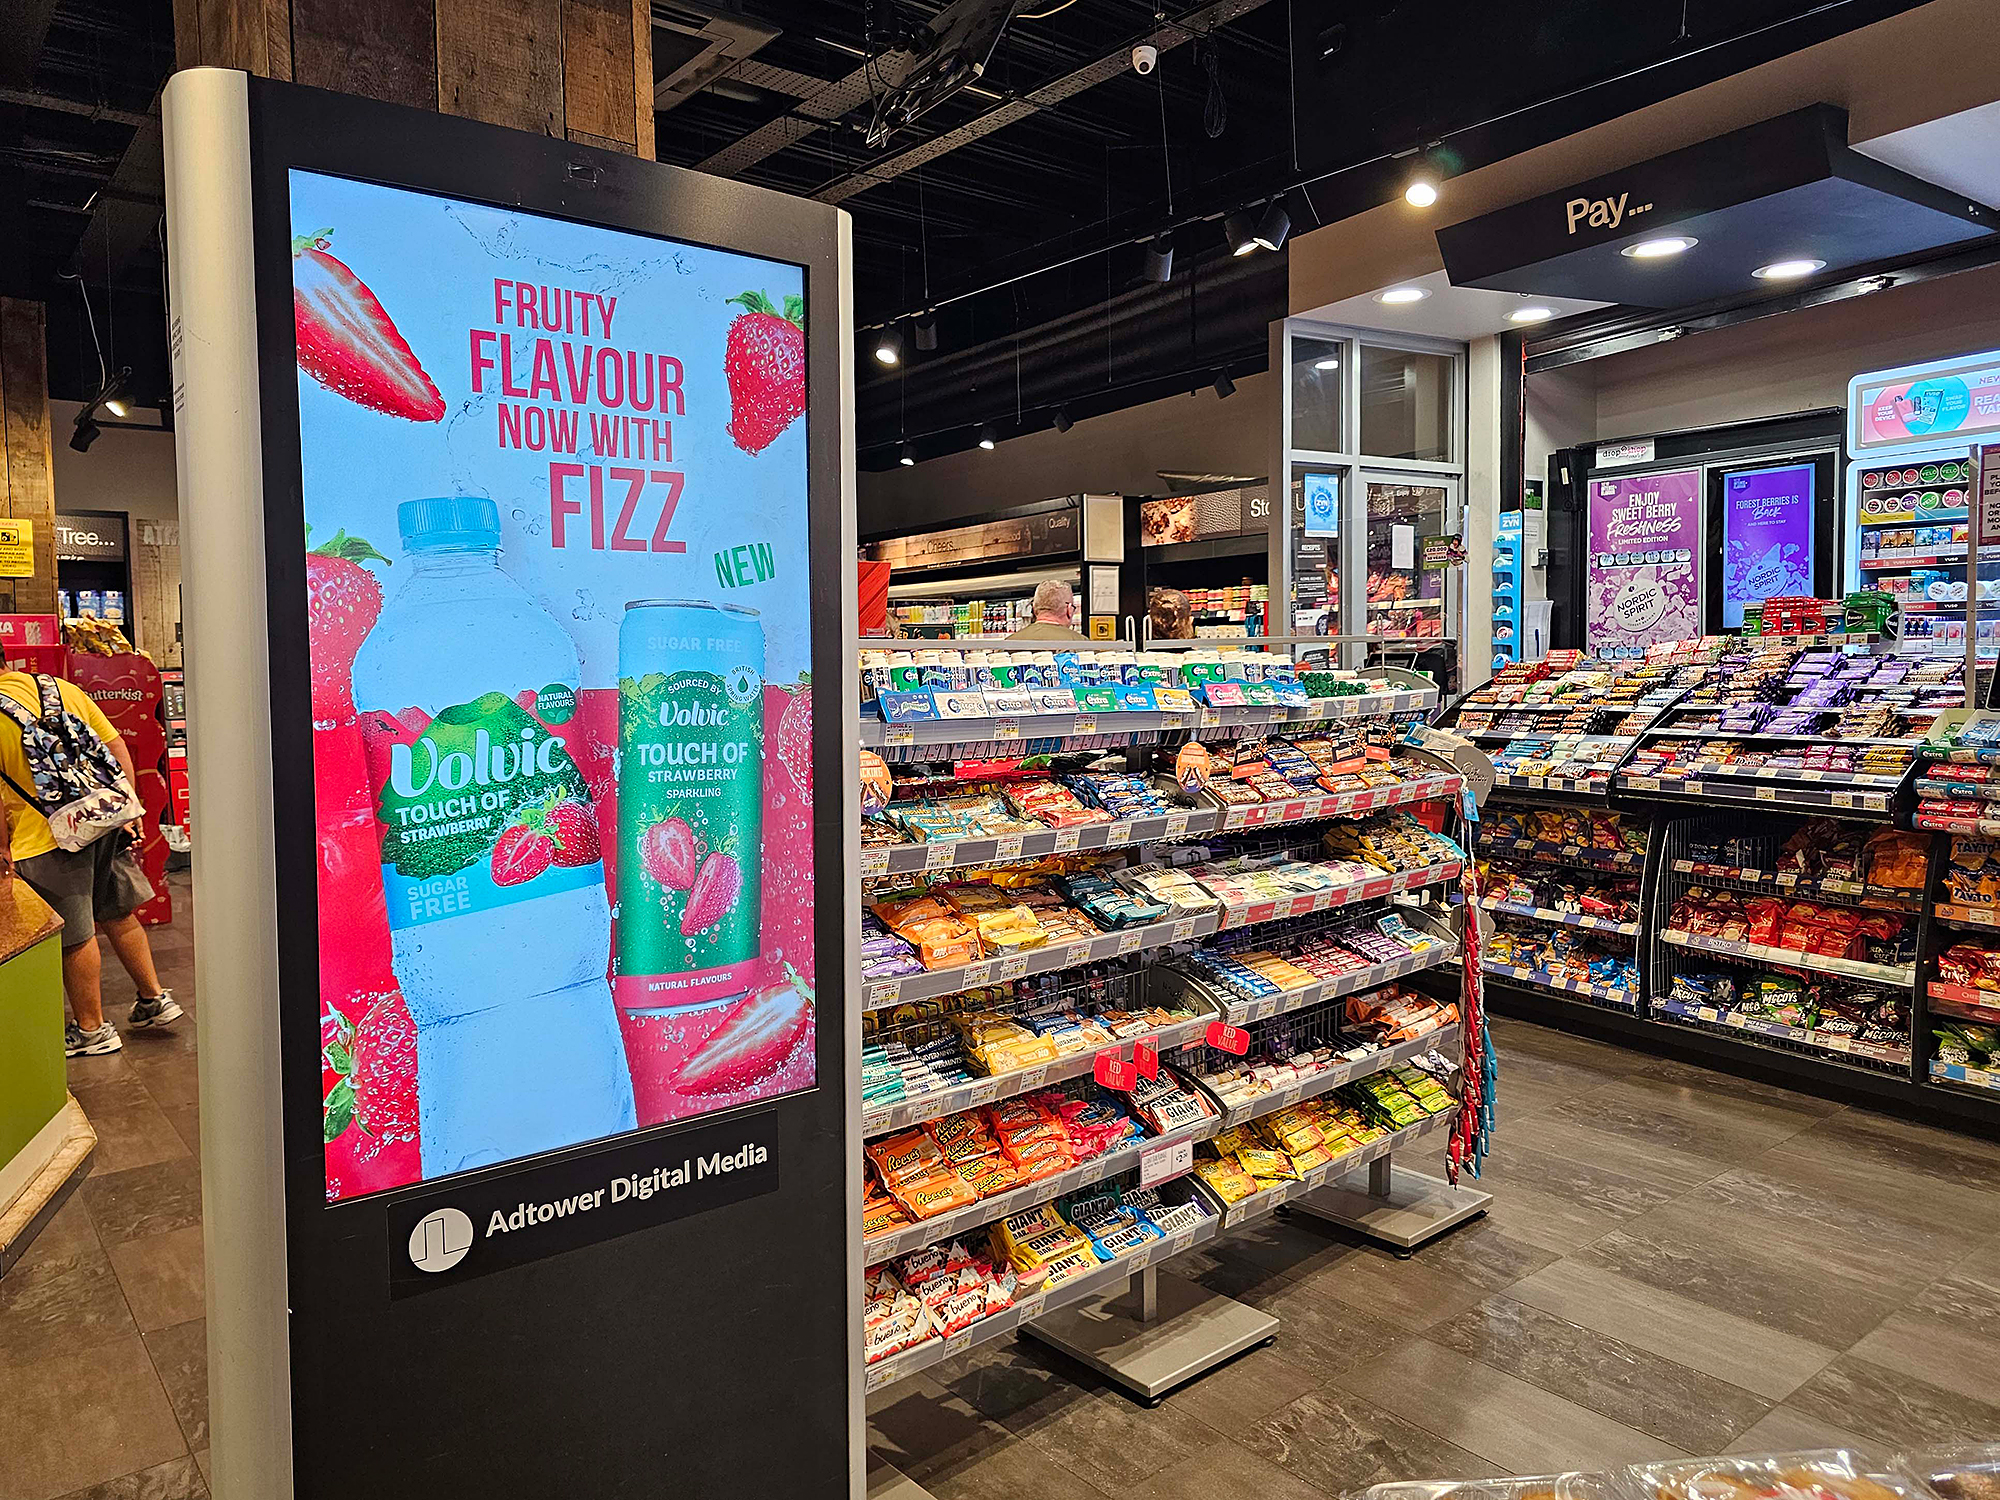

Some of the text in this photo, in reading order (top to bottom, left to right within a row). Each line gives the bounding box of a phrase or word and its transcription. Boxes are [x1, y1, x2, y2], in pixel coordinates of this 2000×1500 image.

[1566, 192, 1653, 235] Pay...
[493, 278, 618, 341] FRUITY
[470, 329, 686, 416] FLAVOUR
[497, 402, 674, 464] NOW WITH
[549, 461, 687, 554] FIZZ
[1629, 491, 1660, 508] ENJOY
[1735, 494, 1799, 510] FOREST BERRIES IS
[1612, 502, 1678, 521] SWEET BERRY
[1502, 519, 1520, 529] ZYN
[714, 542, 776, 589] NEW
[1748, 566, 1782, 586] NORDIC
[1754, 574, 1781, 591] SPIRIT
[1616, 588, 1658, 613] NORDIC
[1623, 599, 1655, 619] SPIRIT
[648, 636, 743, 653] SUGAR FREE
[1507, 662, 1537, 671] CATCH
[88, 688, 144, 701] utterkist
[538, 690, 574, 702] NATURAL
[667, 679, 723, 697] SOURCED BY
[537, 698, 575, 711] FLAVOURS
[659, 701, 729, 727] Volvic
[391, 727, 568, 798] Volvic
[637, 742, 749, 766] TOUCH OF
[1923, 750, 1943, 758] extra
[648, 768, 738, 784] STRAWBERRY
[666, 788, 722, 799] SPARKLING
[1952, 787, 1973, 796] extra
[395, 789, 511, 826] TOUCH OF
[400, 814, 493, 845] STRAWBERRY
[1922, 820, 1943, 828] extra
[406, 876, 469, 902] SUGAR
[1953, 887, 1992, 903] TAYTO
[409, 890, 473, 921] FREE
[648, 973, 733, 992] NATURAL FLAVOURS
[1223, 1025, 1236, 1039] RED
[1217, 1034, 1239, 1051] VALUE
[1109, 1059, 1122, 1073] RED
[1104, 1071, 1126, 1087] VALUE
[1166, 1098, 1200, 1119] GIANT
[936, 1113, 960, 1137] Reese's
[939, 1118, 967, 1144] STICKS
[887, 1148, 920, 1172] Reese's
[485, 1143, 769, 1238] Adtower Digital Media
[916, 1187, 953, 1206] Reese's
[1072, 1198, 1108, 1219] GIANT
[1164, 1204, 1198, 1232] GIANT
[863, 1214, 890, 1230] eese's
[1007, 1207, 1045, 1233] GIANT
[1012, 1229, 1029, 1240] BAR.
[1028, 1228, 1068, 1252] GIANT
[1103, 1226, 1140, 1250] GIANT
[911, 1250, 939, 1269] bueno
[921, 1276, 949, 1296] bueno
[1050, 1271, 1068, 1284] BAR.
[864, 1302, 880, 1317] eno
[949, 1293, 977, 1315] bueno
[873, 1324, 901, 1346] bueno
